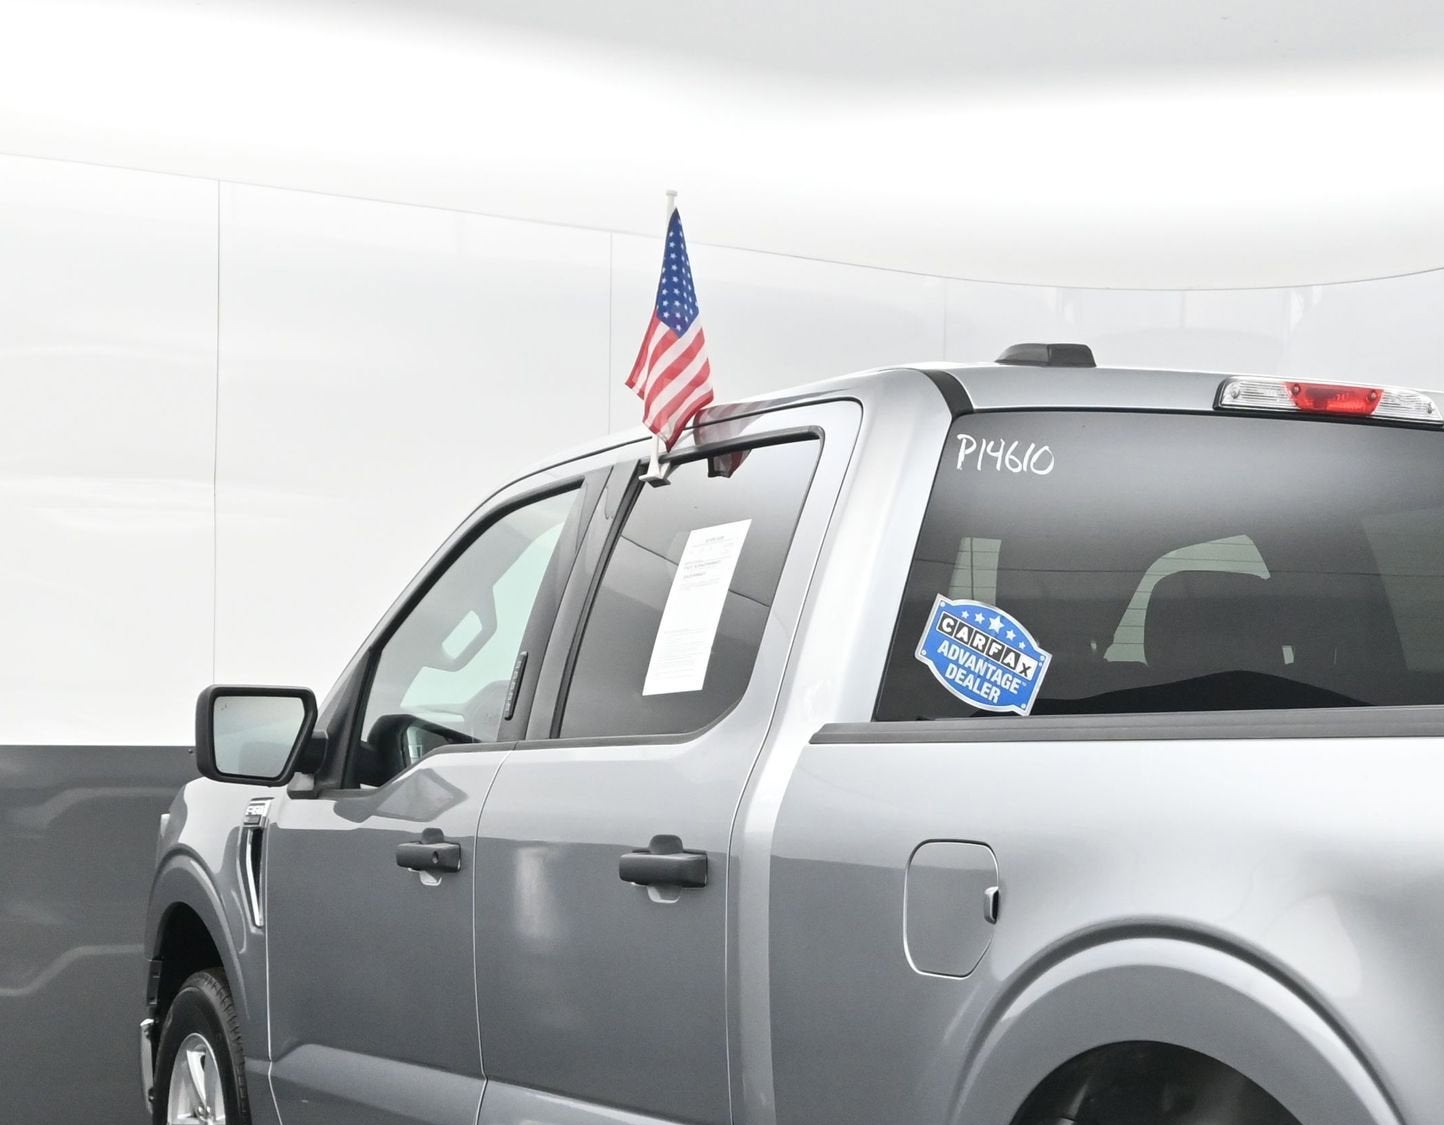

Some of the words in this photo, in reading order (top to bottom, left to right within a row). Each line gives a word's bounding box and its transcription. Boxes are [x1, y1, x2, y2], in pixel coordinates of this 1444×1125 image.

[956, 433, 1055, 475] P14610
[938, 613, 1034, 679] CARFAX
[945, 661, 1001, 704] DEALER
